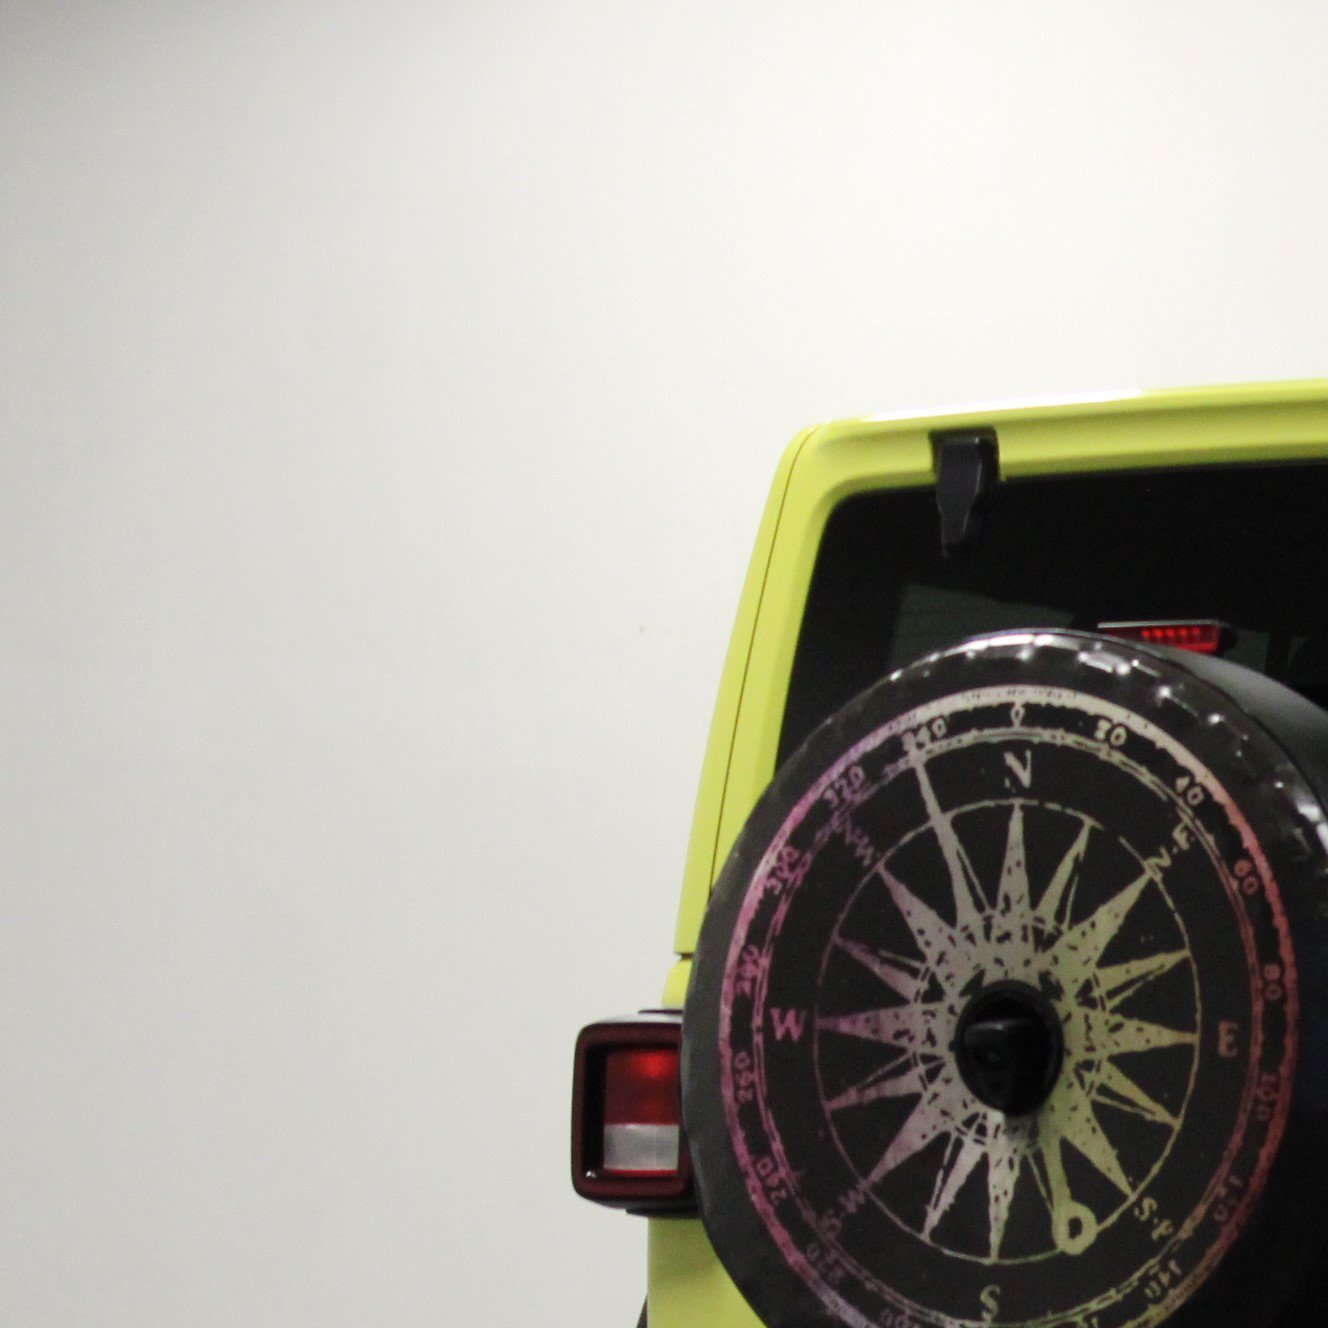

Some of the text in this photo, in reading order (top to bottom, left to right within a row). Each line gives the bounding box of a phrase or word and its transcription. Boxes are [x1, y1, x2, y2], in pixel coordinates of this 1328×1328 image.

[1003, 749, 1033, 789] N
[770, 1006, 808, 1042] W
[1217, 1020, 1239, 1059] E
[979, 1284, 1002, 1324] S
